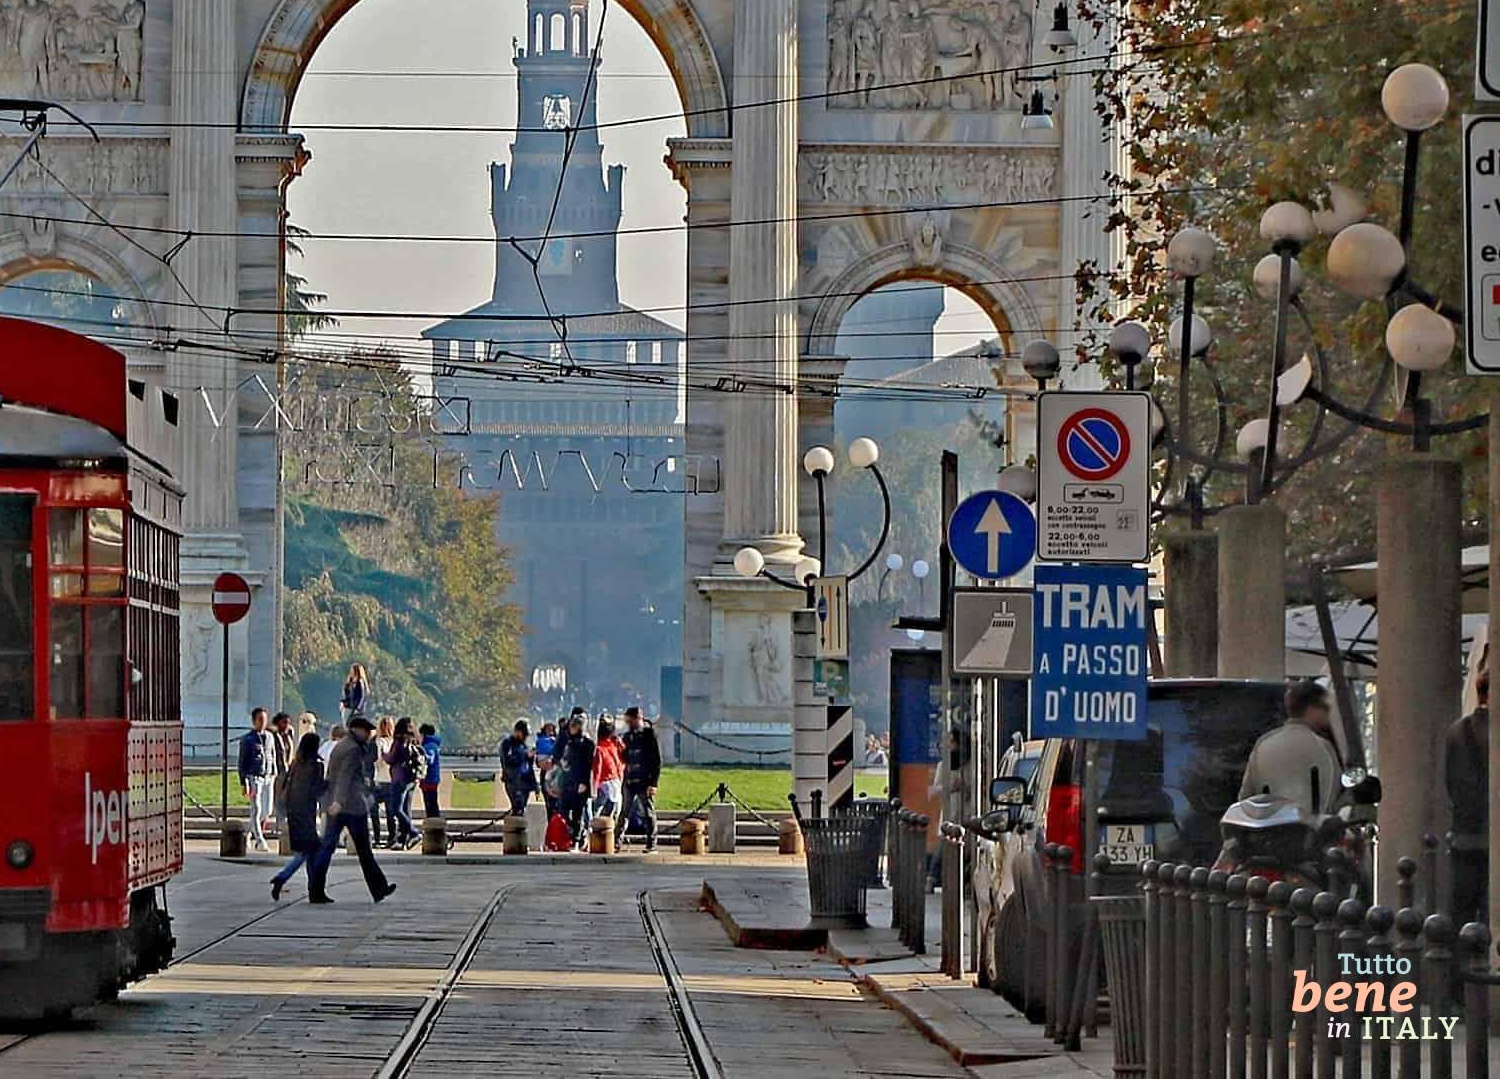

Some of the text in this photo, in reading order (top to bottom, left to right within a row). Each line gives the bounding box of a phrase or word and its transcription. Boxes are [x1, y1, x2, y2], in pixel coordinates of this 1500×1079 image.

[1036, 582, 1146, 629] TRAM
[1039, 642, 1140, 676] A PASSO
